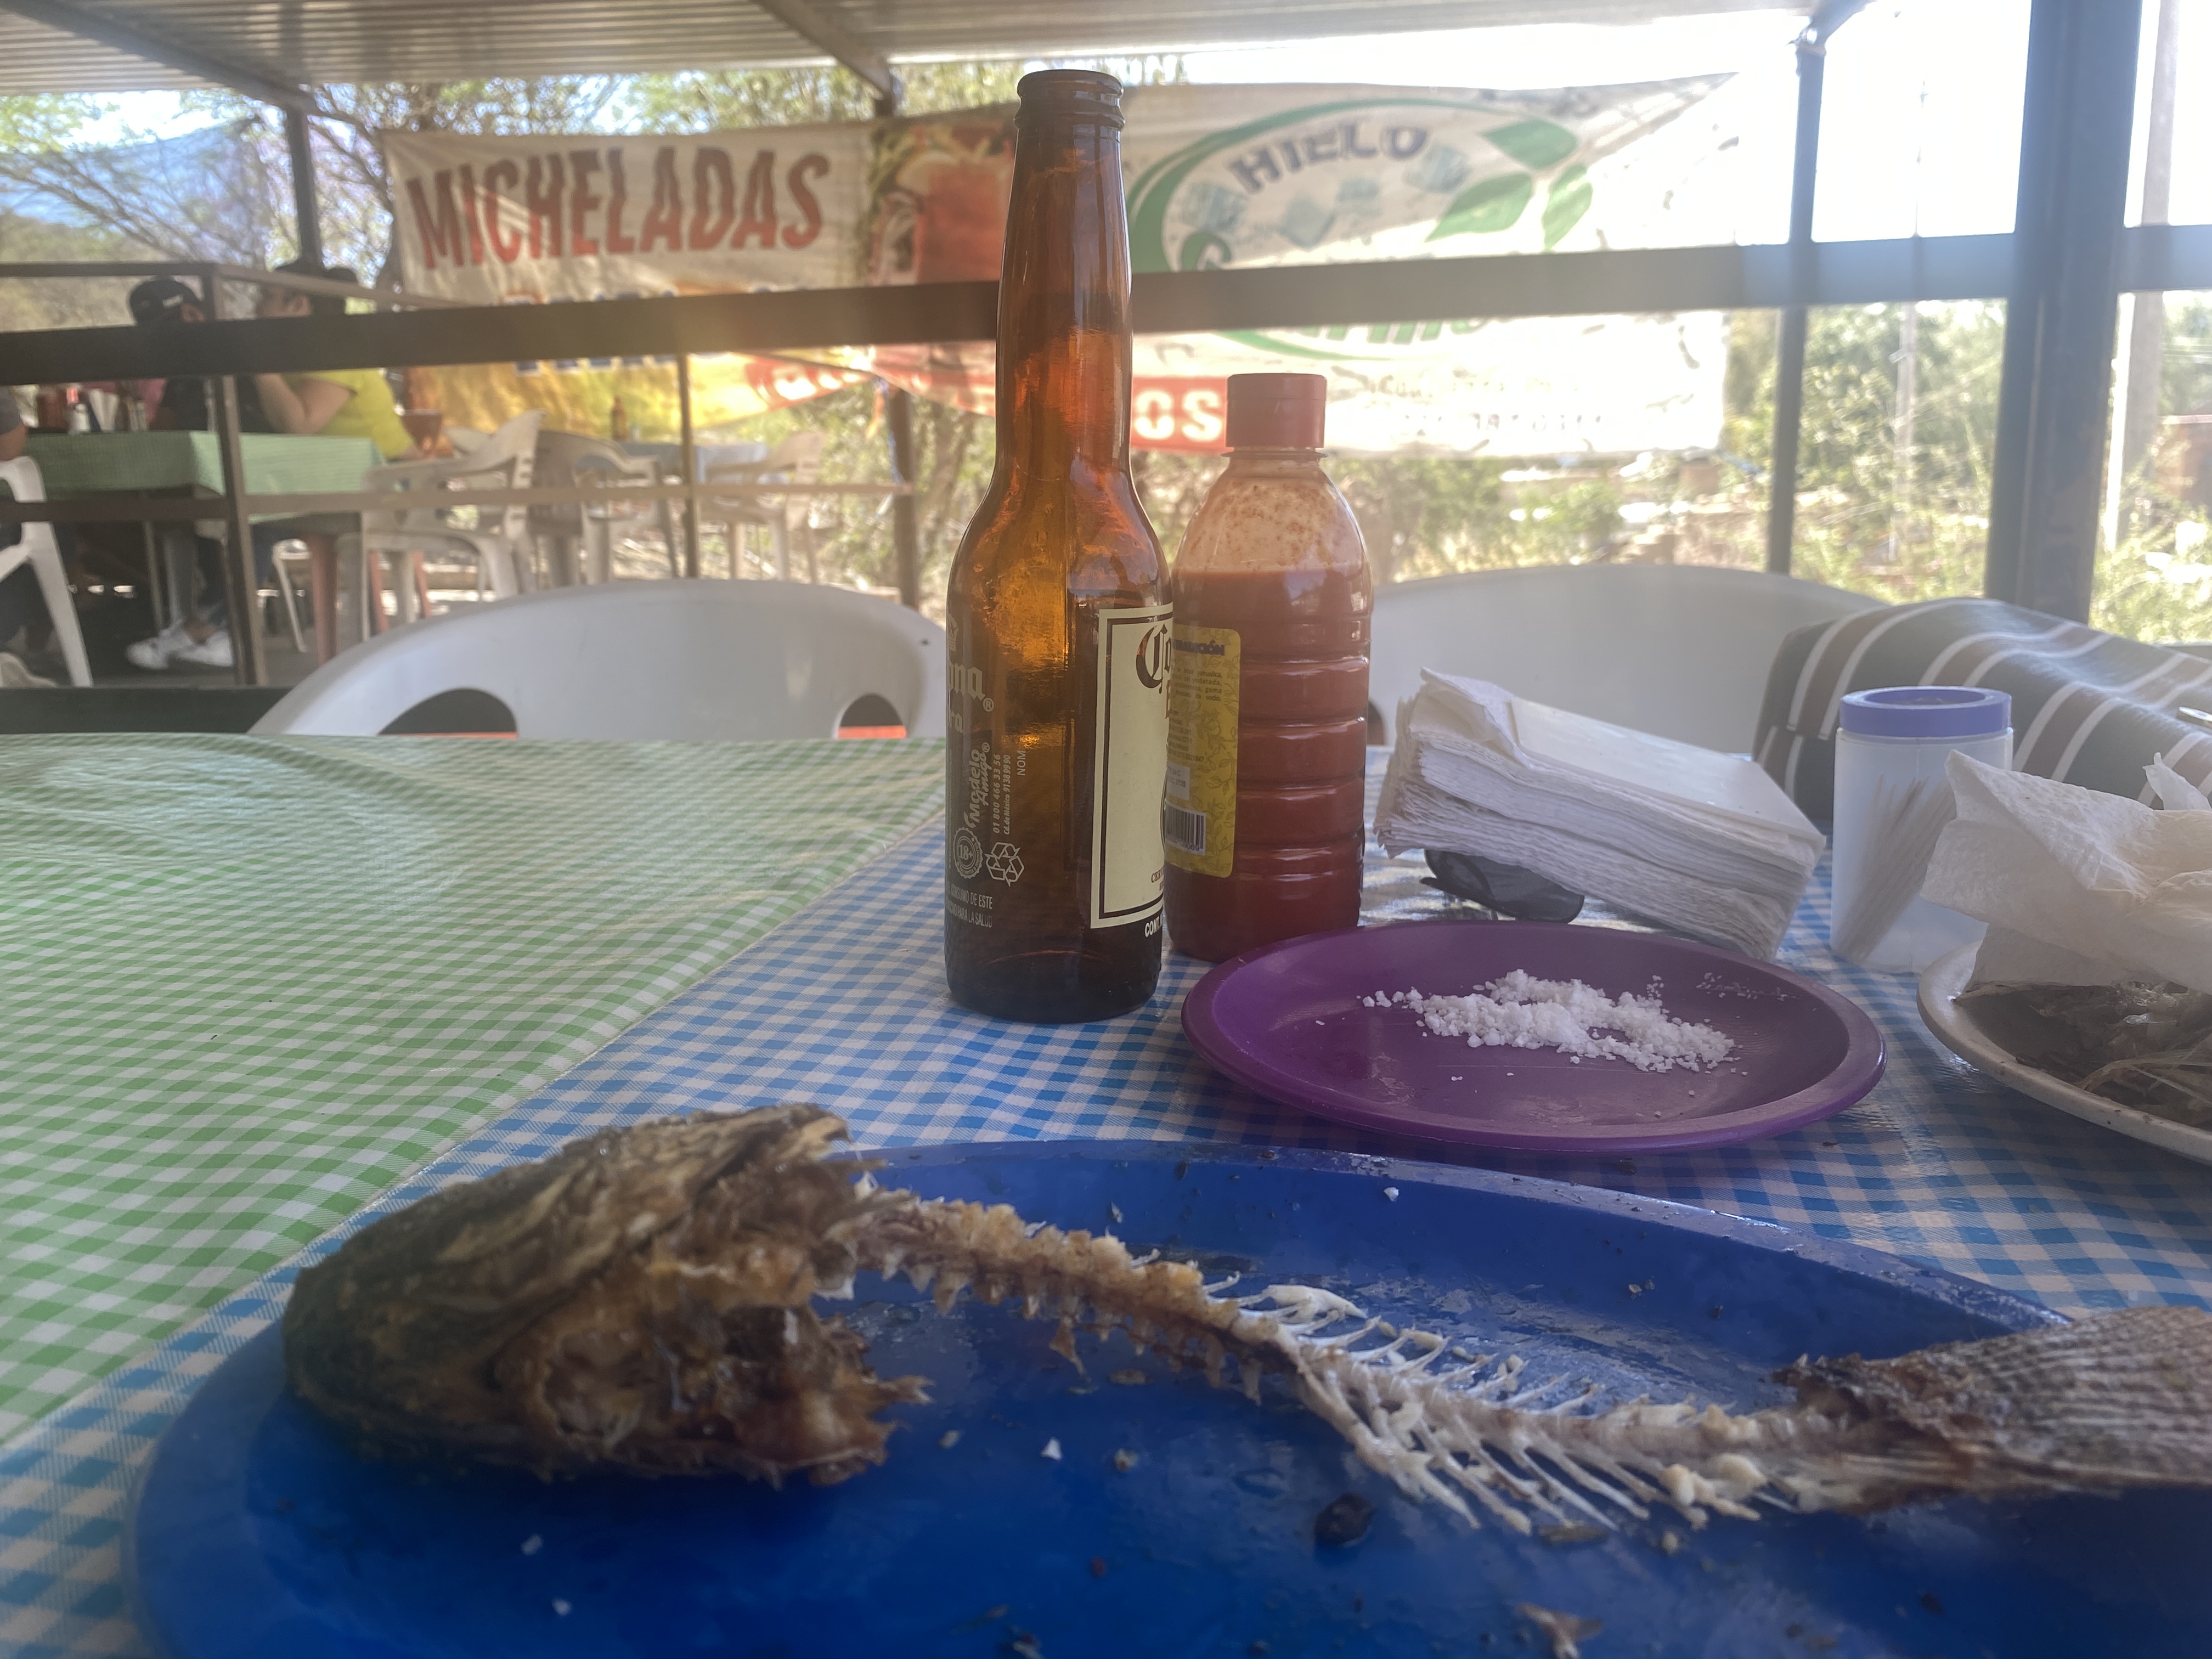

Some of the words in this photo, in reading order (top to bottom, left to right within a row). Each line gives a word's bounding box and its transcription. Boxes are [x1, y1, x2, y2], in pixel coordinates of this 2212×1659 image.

[1227, 122, 1427, 195] HIELO
[405, 146, 831, 271] MICHELADAS
[994, 754, 1001, 766] 56
[1017, 749, 1026, 776] NOM
[975, 752, 992, 806] Amigo
[994, 768, 1001, 780] 33
[967, 749, 981, 824] Modelo
[993, 822, 1000, 833] 01
[959, 845, 973, 860] 18+
[970, 892, 977, 906] DE
[979, 894, 993, 909] ESTE
[957, 905, 968, 922] PARA
[968, 911, 975, 924] LA
[975, 912, 992, 928] SALUD
